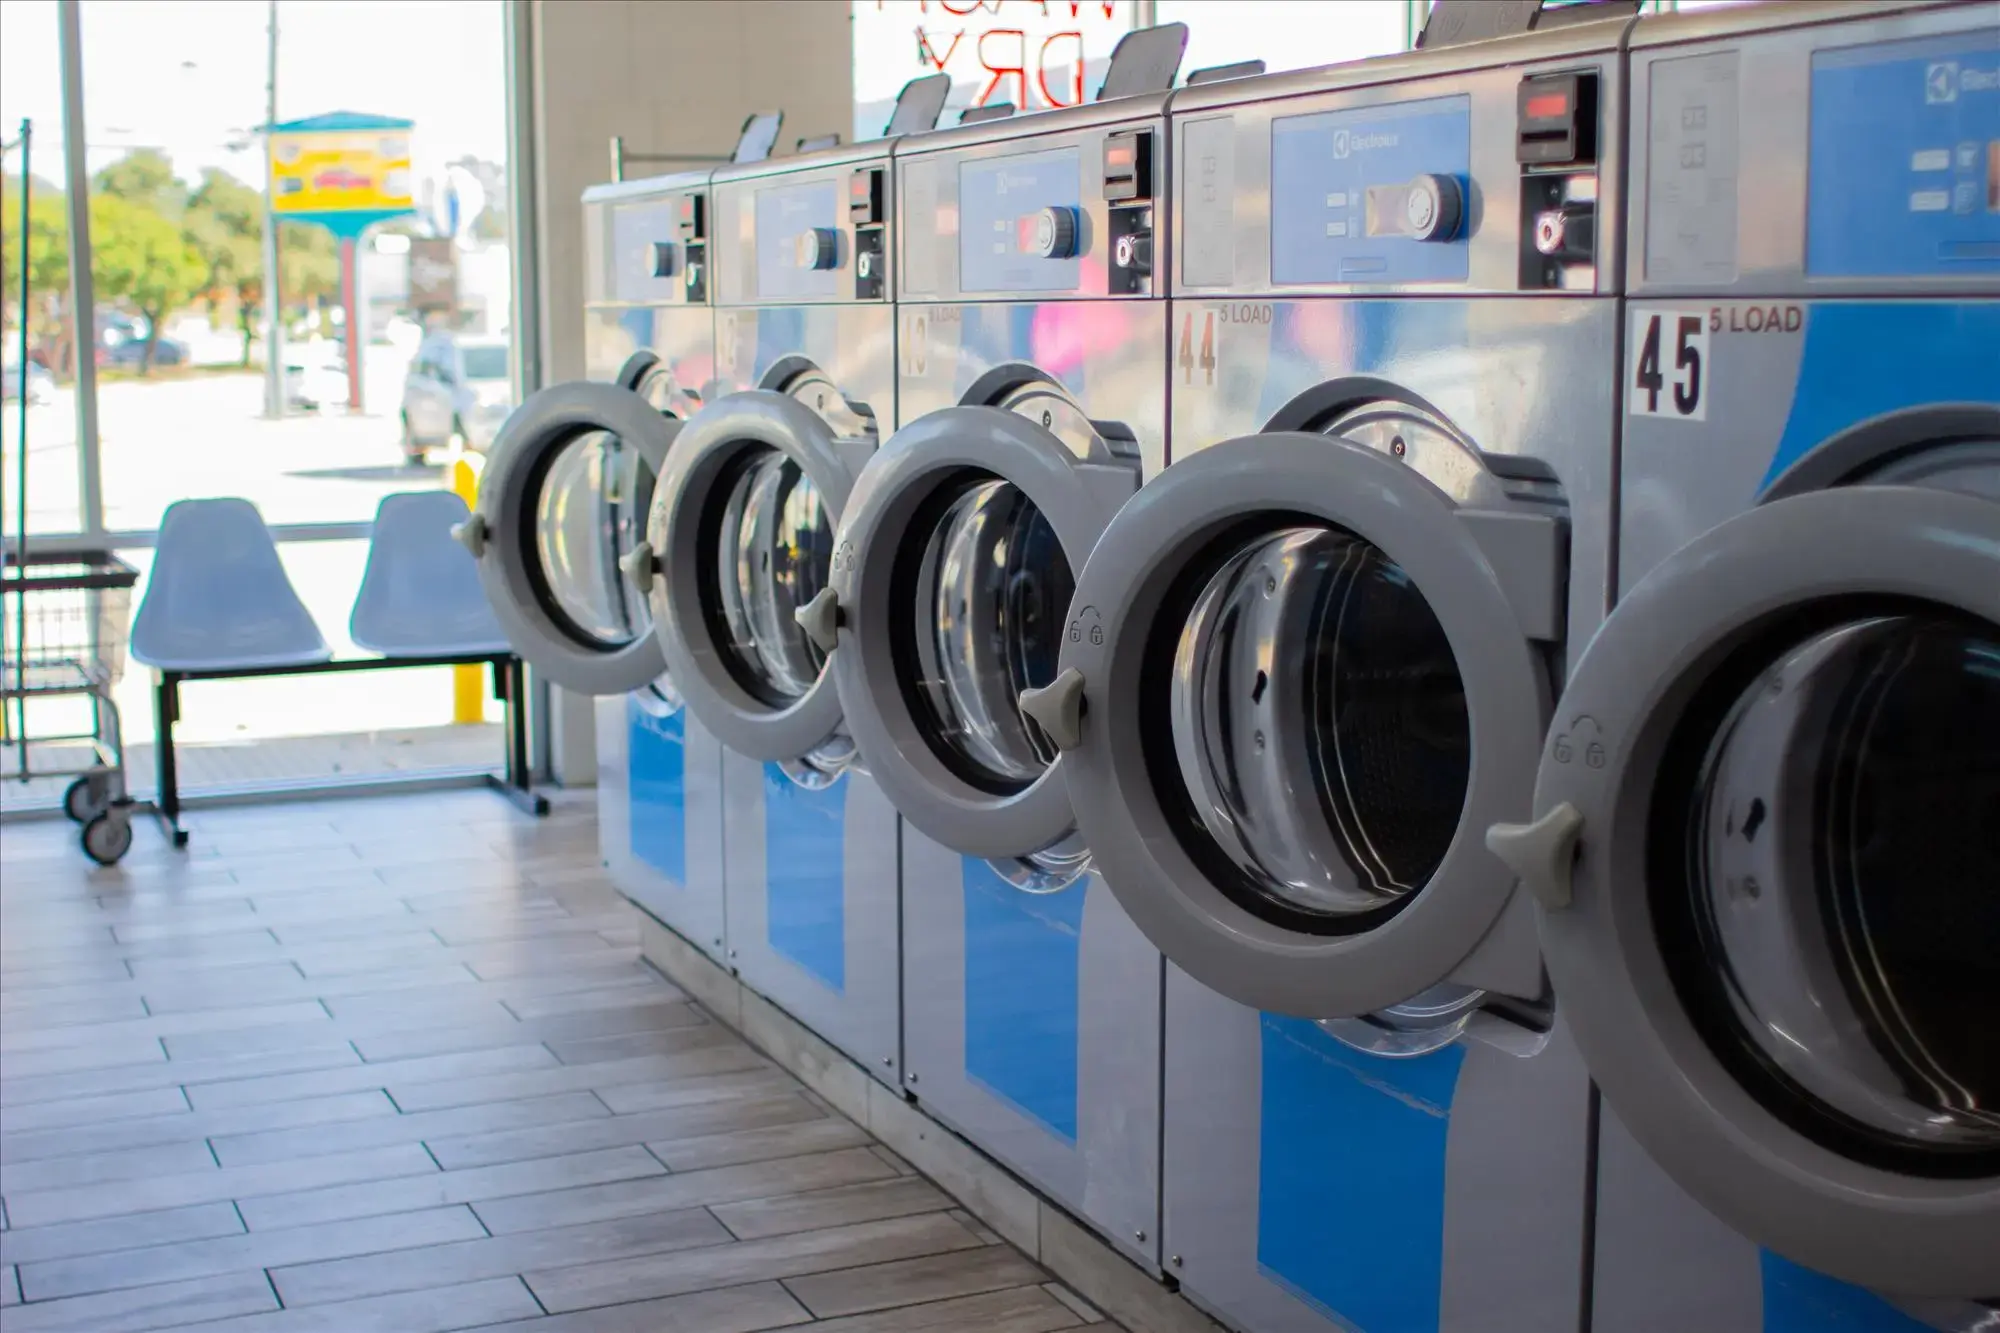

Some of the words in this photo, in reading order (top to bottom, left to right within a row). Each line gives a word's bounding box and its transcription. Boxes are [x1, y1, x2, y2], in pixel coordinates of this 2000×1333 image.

[1220, 304, 1228, 323] 5
[1232, 303, 1271, 324] LOAD
[1709, 307, 1722, 333] 5
[1730, 306, 1802, 333] LOAD
[1179, 311, 1215, 386] 44
[1636, 314, 1702, 415] 45
